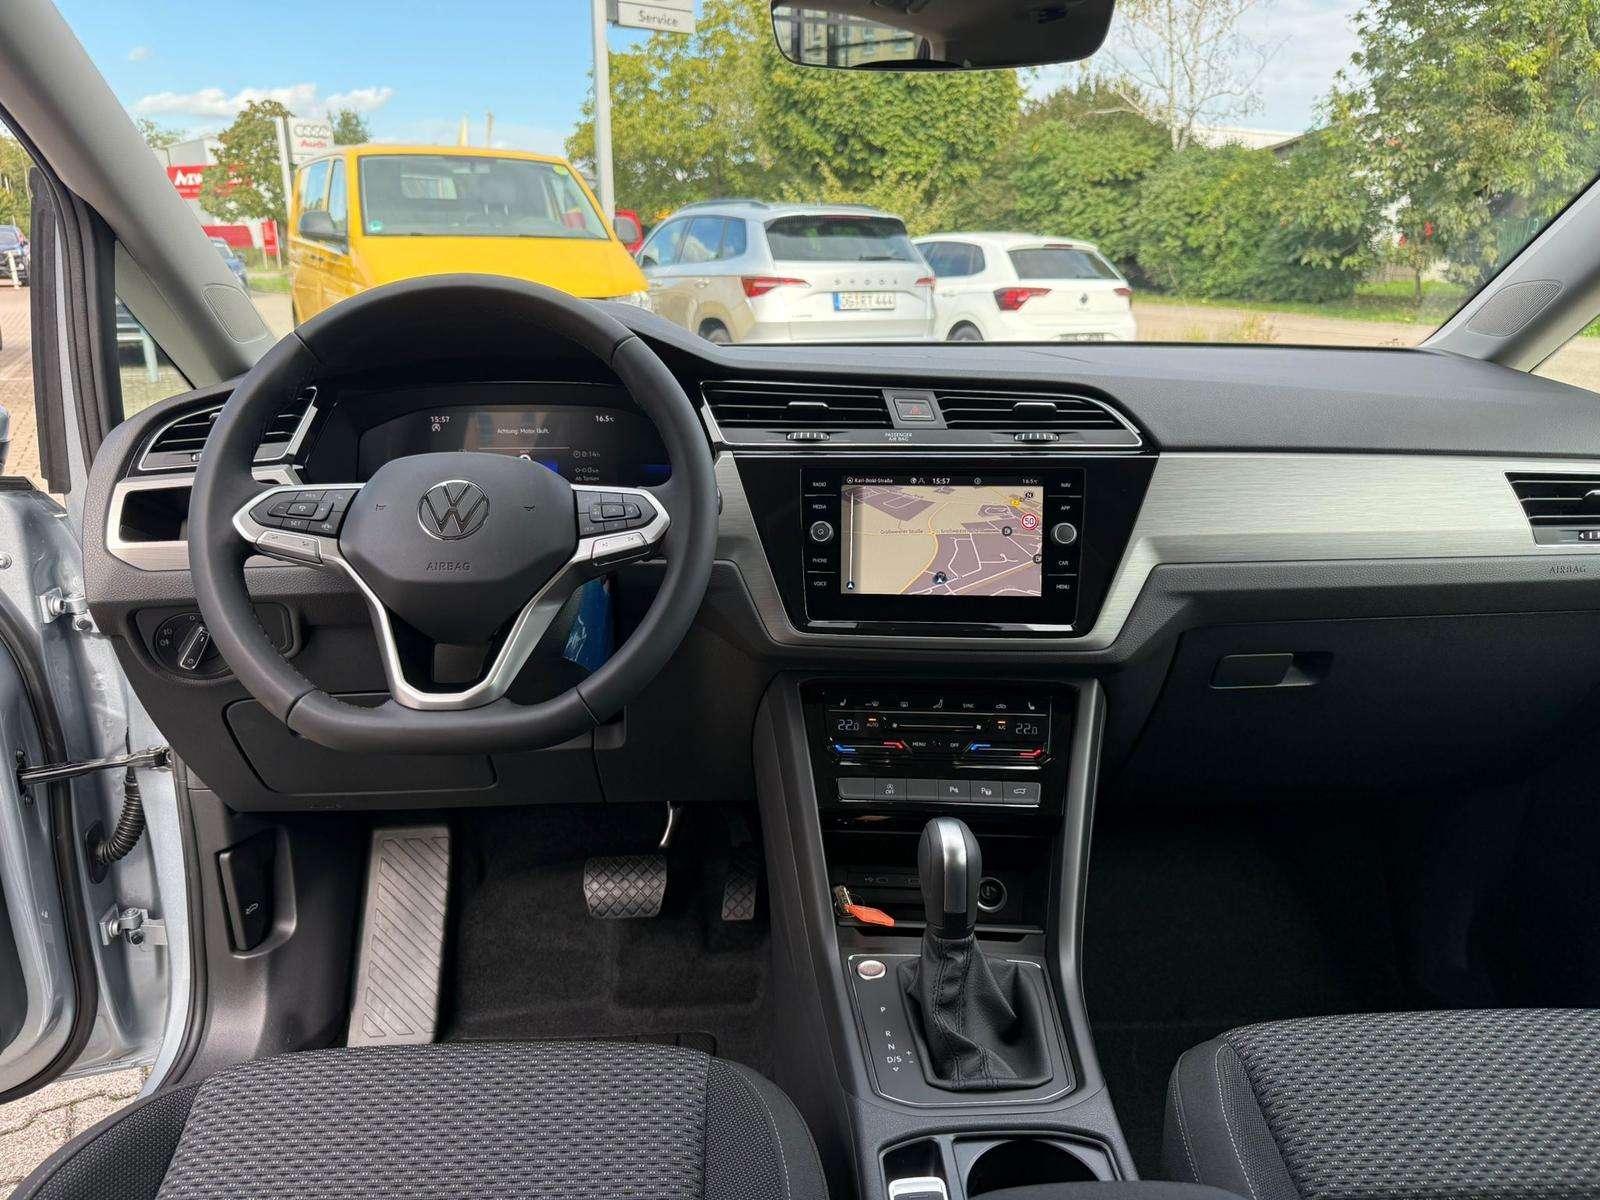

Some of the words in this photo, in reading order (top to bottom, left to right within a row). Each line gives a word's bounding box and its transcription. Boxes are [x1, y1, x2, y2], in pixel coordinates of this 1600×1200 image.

[639, 9, 679, 26] Service
[932, 477, 950, 485] 15:57
[1024, 517, 1035, 526] 50
[426, 561, 471, 571] AIRBAG
[1550, 565, 1586, 574] AIRBAG
